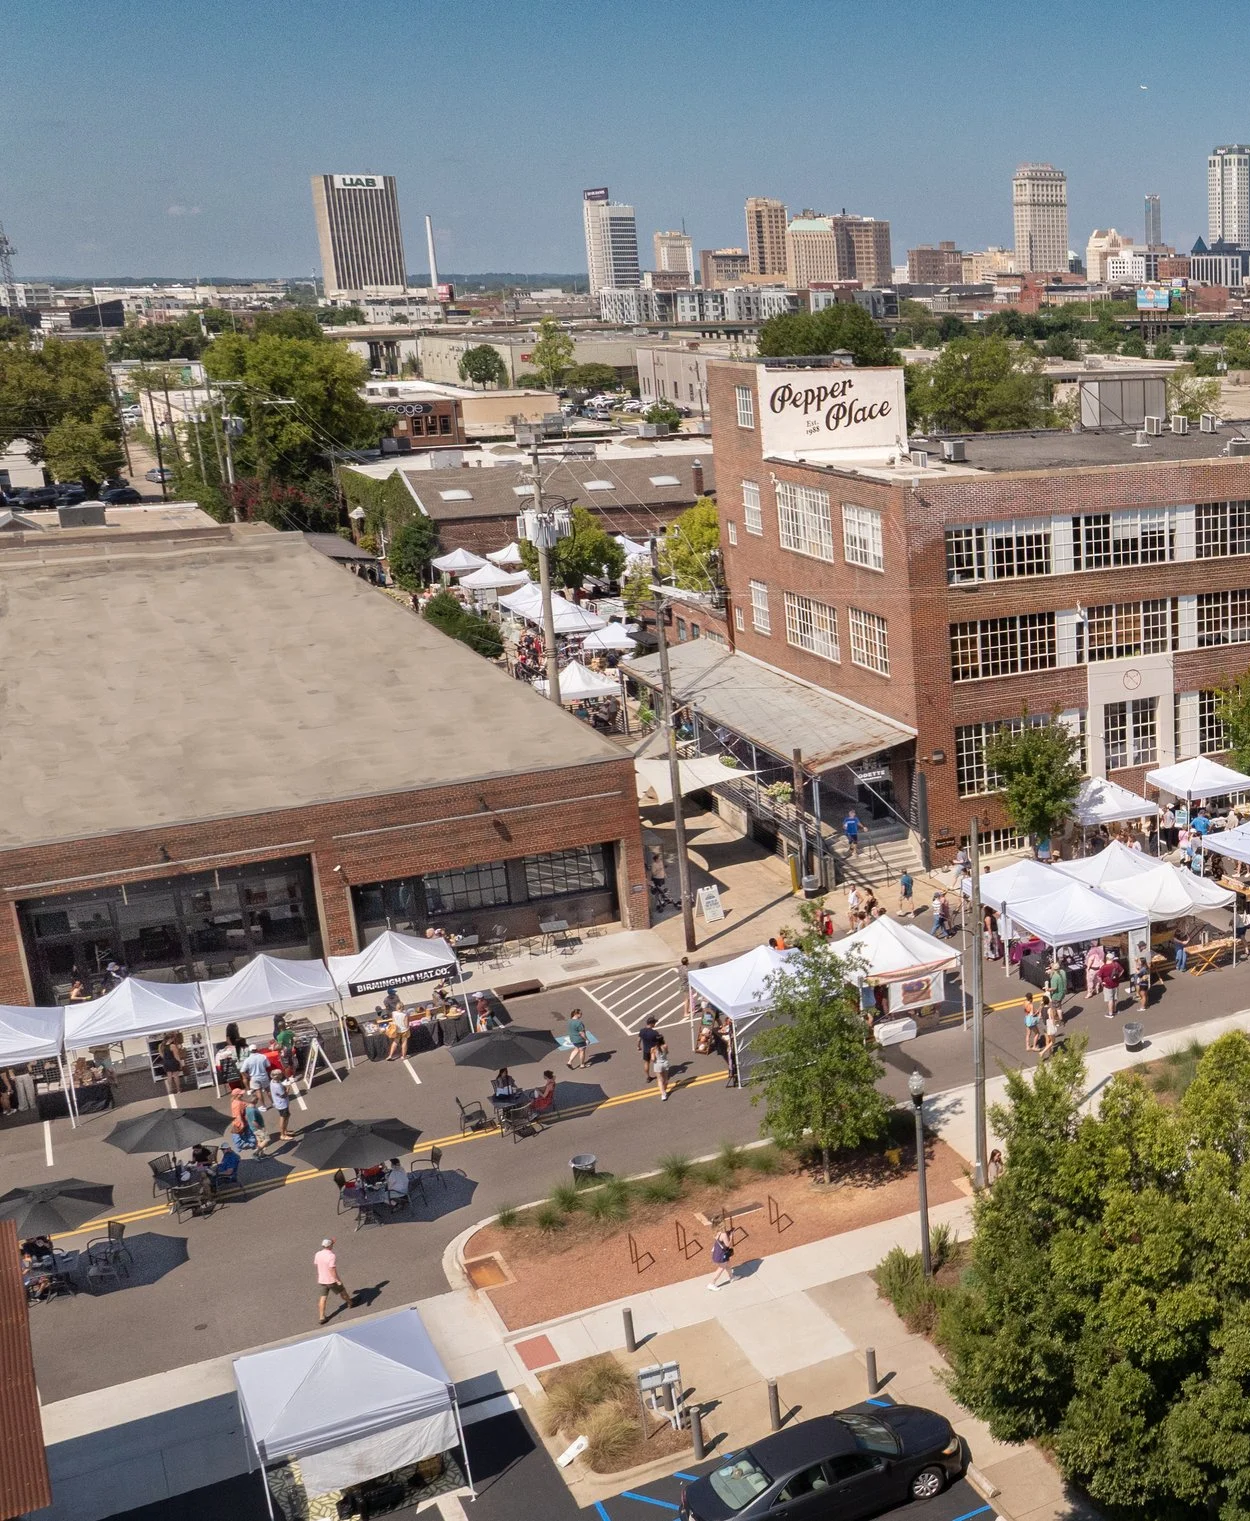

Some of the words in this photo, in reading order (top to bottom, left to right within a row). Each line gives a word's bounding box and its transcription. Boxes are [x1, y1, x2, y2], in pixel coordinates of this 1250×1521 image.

[342, 177, 377, 188] UAB
[769, 378, 854, 415] Pepper
[825, 397, 892, 431] Place
[806, 420, 819, 428] Est.
[805, 425, 820, 436] 1988
[858, 769, 885, 779] ODETTE
[356, 974, 415, 993] BIRMINGHAM
[416, 970, 434, 981] HAT
[433, 966, 451, 977] CO.
